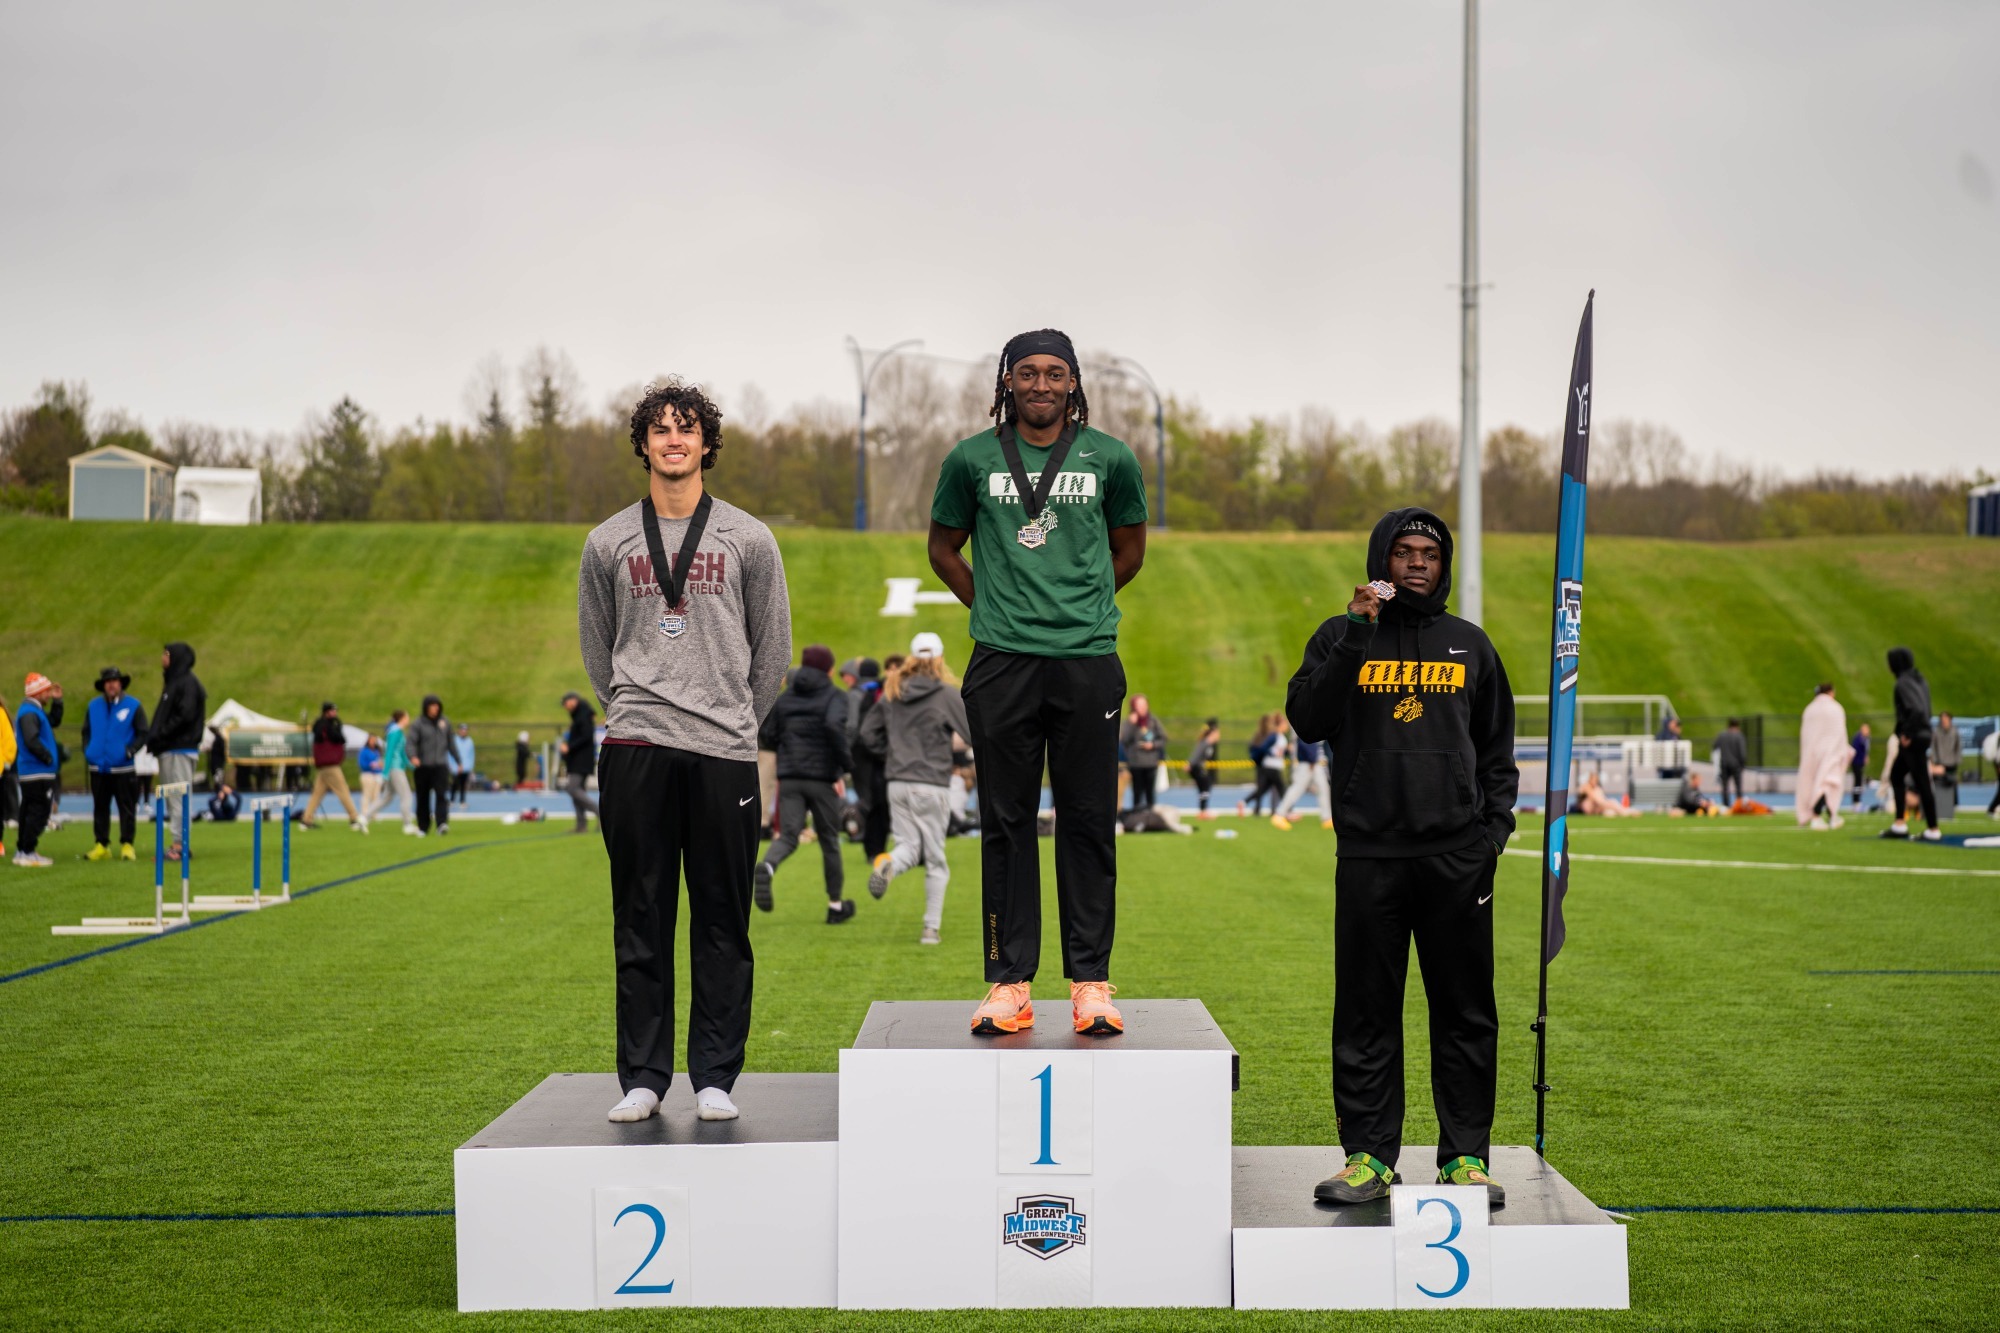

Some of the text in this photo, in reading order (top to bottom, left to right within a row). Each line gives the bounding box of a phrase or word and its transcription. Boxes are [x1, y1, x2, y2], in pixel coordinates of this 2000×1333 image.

[1056, 496, 1088, 504] FIELD
[627, 552, 725, 586] WSH
[630, 582, 724, 599] TRAC FIELD
[1363, 685, 1456, 693] TRACK & FIELD
[1030, 1064, 1061, 1165] 1
[1026, 1208, 1064, 1219] GREAT
[1006, 1213, 1083, 1234] MIDWEST
[1006, 1231, 1083, 1242] ATHLETIC CONFERENCE
[613, 1203, 674, 1295] 2
[1416, 1198, 1470, 1298] 3
